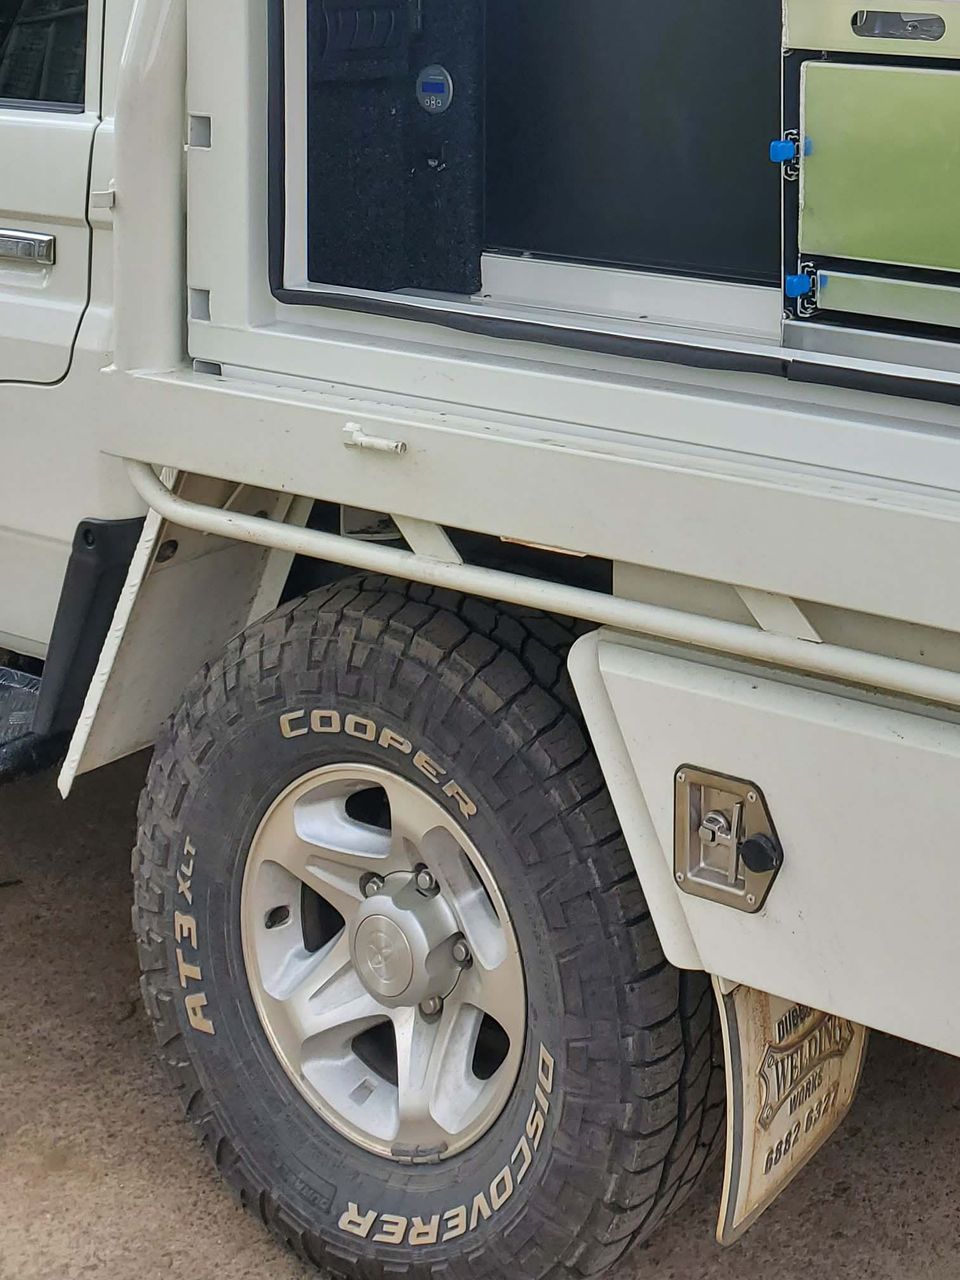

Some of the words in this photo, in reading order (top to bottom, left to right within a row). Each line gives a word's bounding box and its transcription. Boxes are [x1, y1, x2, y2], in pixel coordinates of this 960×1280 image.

[279, 708, 478, 820] COOPER
[174, 910, 216, 1036] AT3
[774, 1015, 844, 1102] WELDING
[788, 1068, 823, 1116] WORKS
[338, 1041, 555, 1246] DISCOVERER
[763, 1120, 801, 1175] 6882
[803, 1081, 840, 1134] 6327
